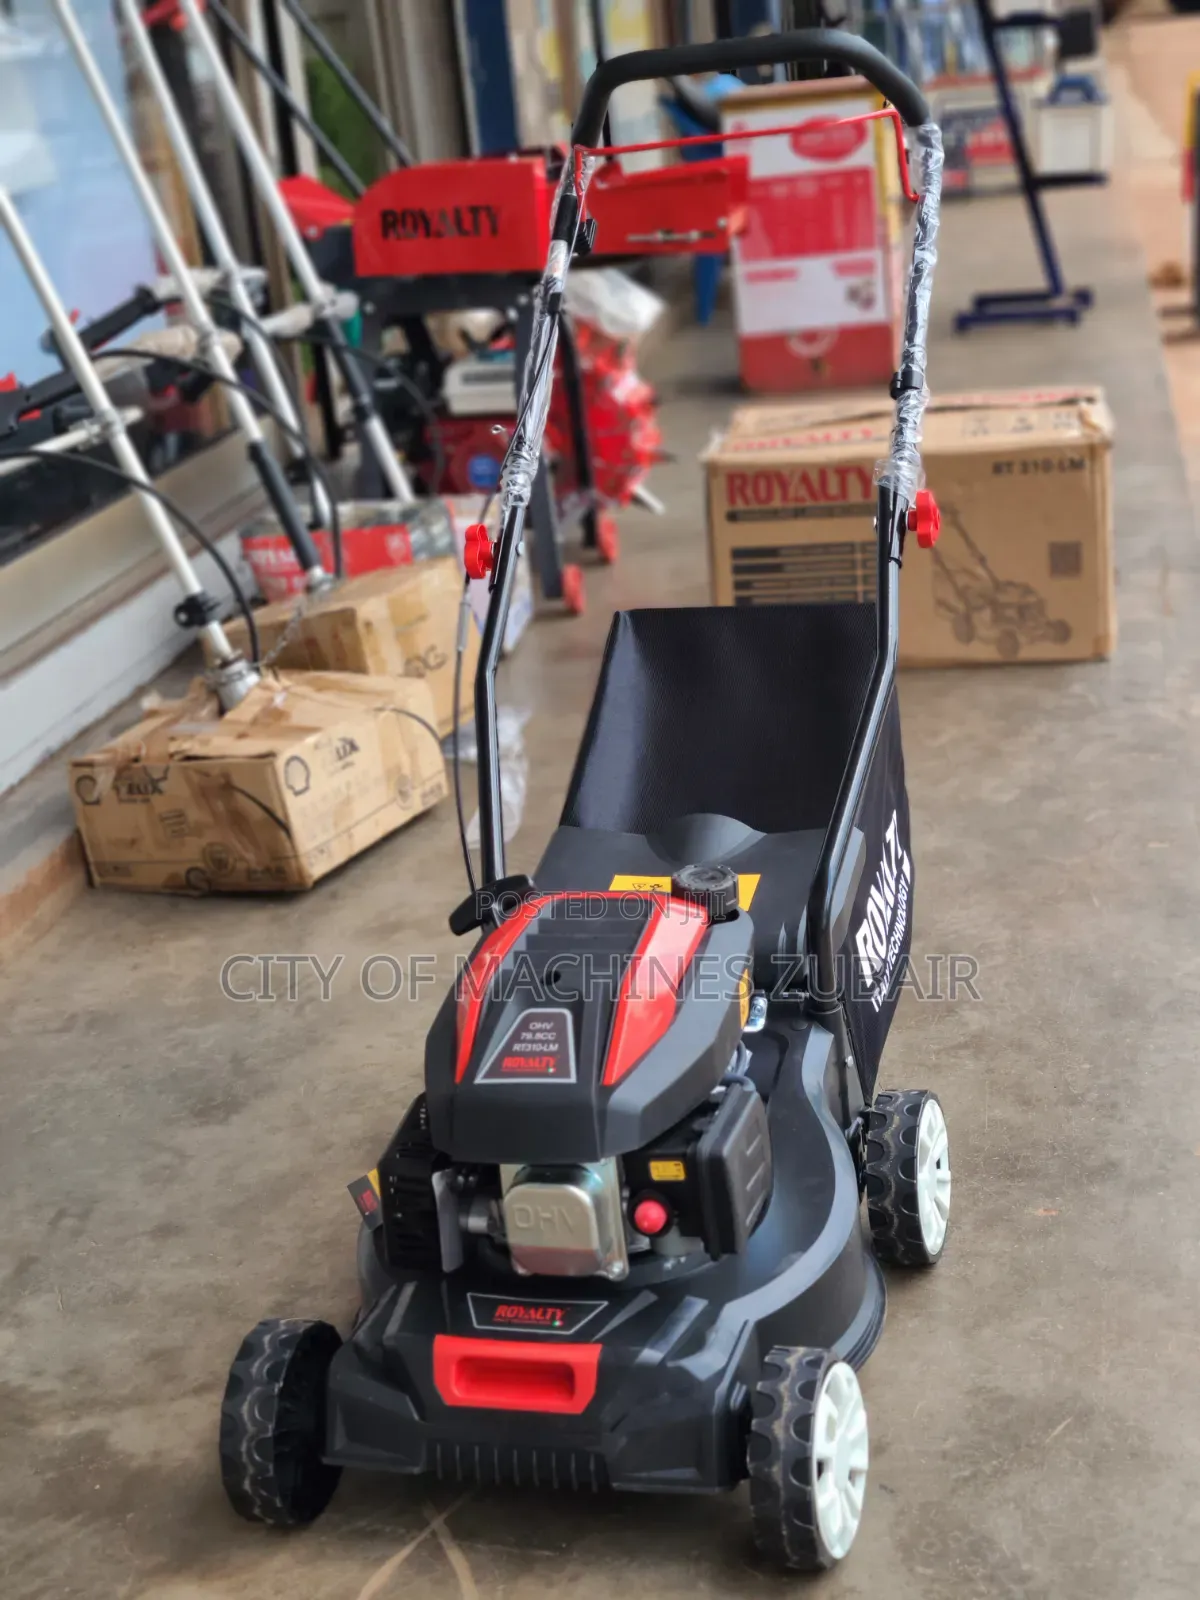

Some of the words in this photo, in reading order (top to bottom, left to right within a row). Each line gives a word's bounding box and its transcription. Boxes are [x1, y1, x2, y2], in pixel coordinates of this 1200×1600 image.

[380, 204, 500, 240] ROYALTY
[725, 464, 873, 507] ROYALTY
[502, 1056, 556, 1068] ROYALTY
[494, 1304, 565, 1320] ROYALTY
